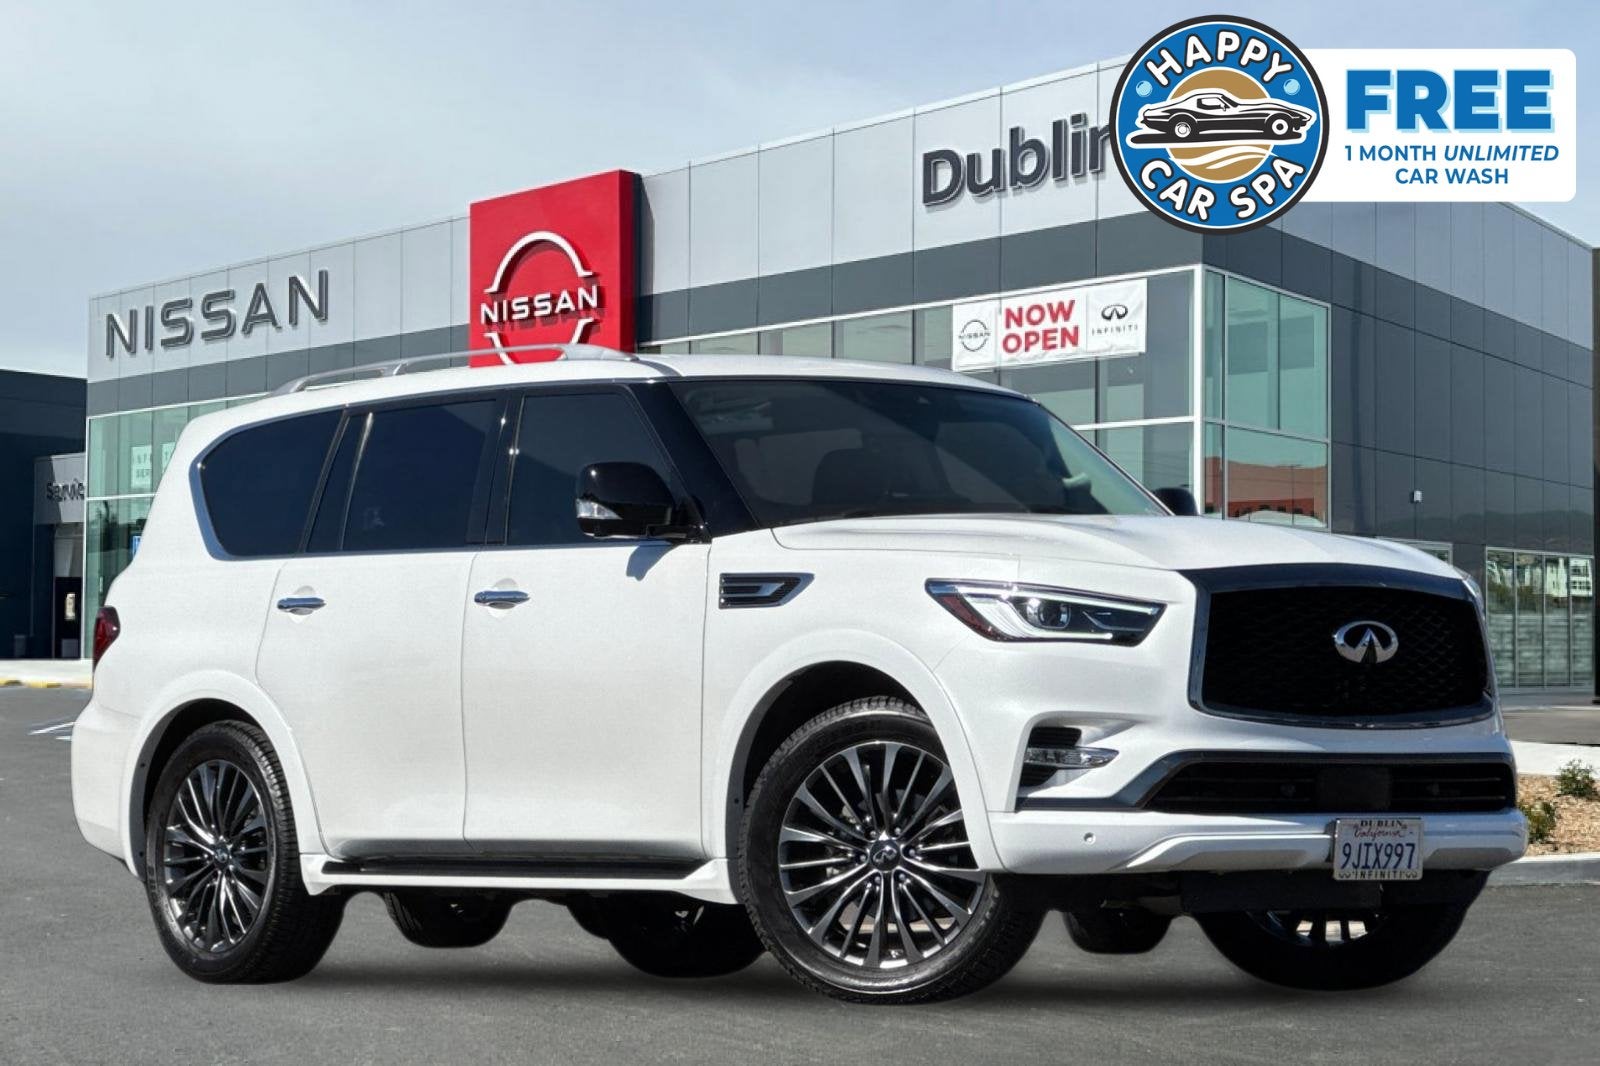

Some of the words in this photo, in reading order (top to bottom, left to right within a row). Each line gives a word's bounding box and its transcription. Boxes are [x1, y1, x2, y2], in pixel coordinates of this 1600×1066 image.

[105, 269, 329, 359] NISSAN
[480, 284, 599, 325] NISSAN
[1005, 299, 1076, 329] NOW
[1002, 325, 1080, 354] OPEN
[1092, 324, 1138, 336] INFINITI
[1341, 842, 1416, 870] 9JIX997
